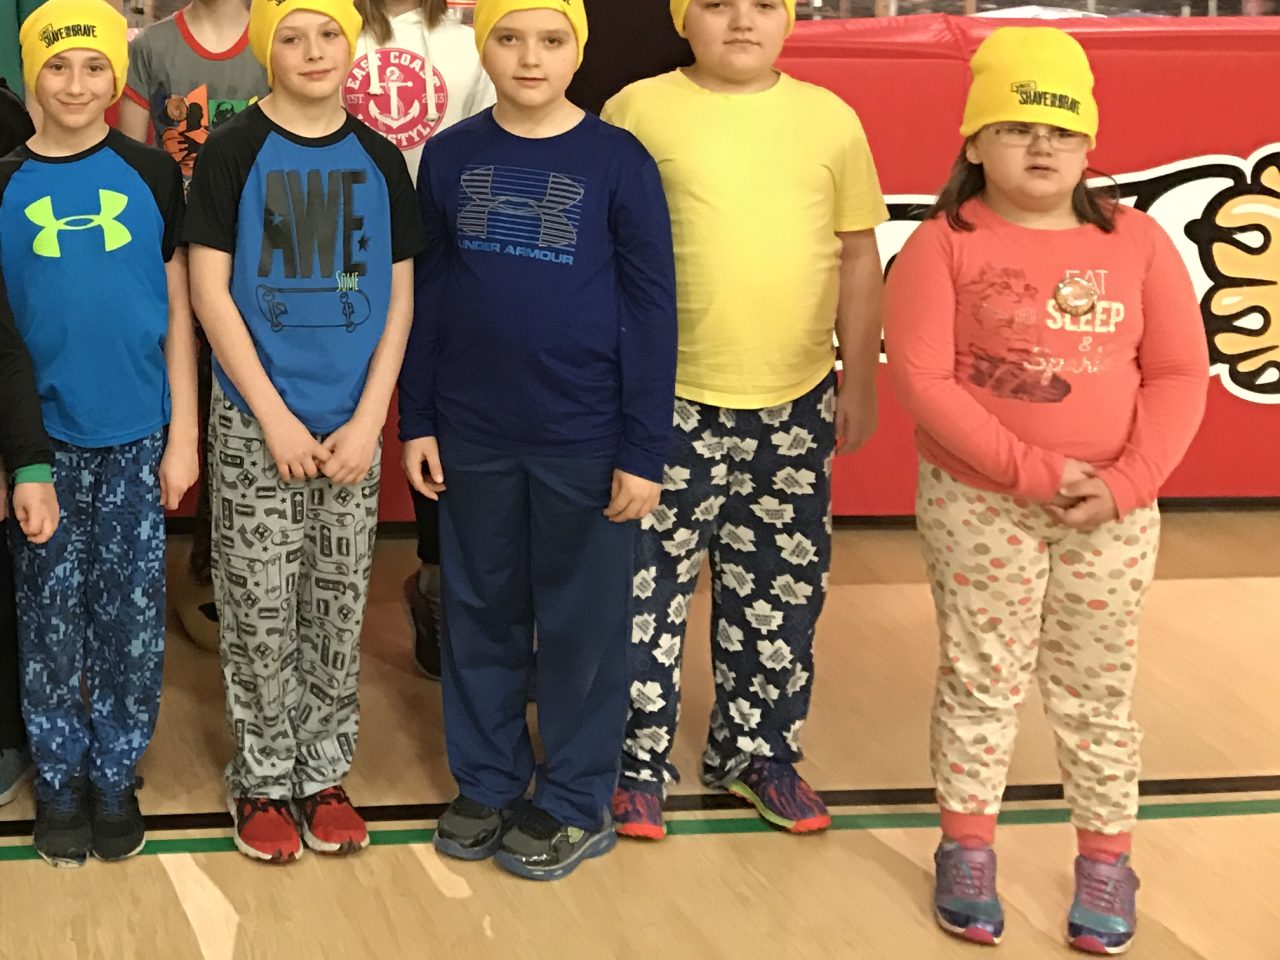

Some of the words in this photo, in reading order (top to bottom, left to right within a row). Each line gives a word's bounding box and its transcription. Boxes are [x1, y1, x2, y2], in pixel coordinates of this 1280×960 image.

[43, 27, 64, 48] SHAVE
[71, 24, 98, 38] BRAVE
[1018, 90, 1050, 107] SHAVE
[257, 169, 368, 279] AWE
[458, 239, 500, 253] UNDER
[504, 243, 574, 266] ARMOUR
[335, 270, 360, 292] SOME
